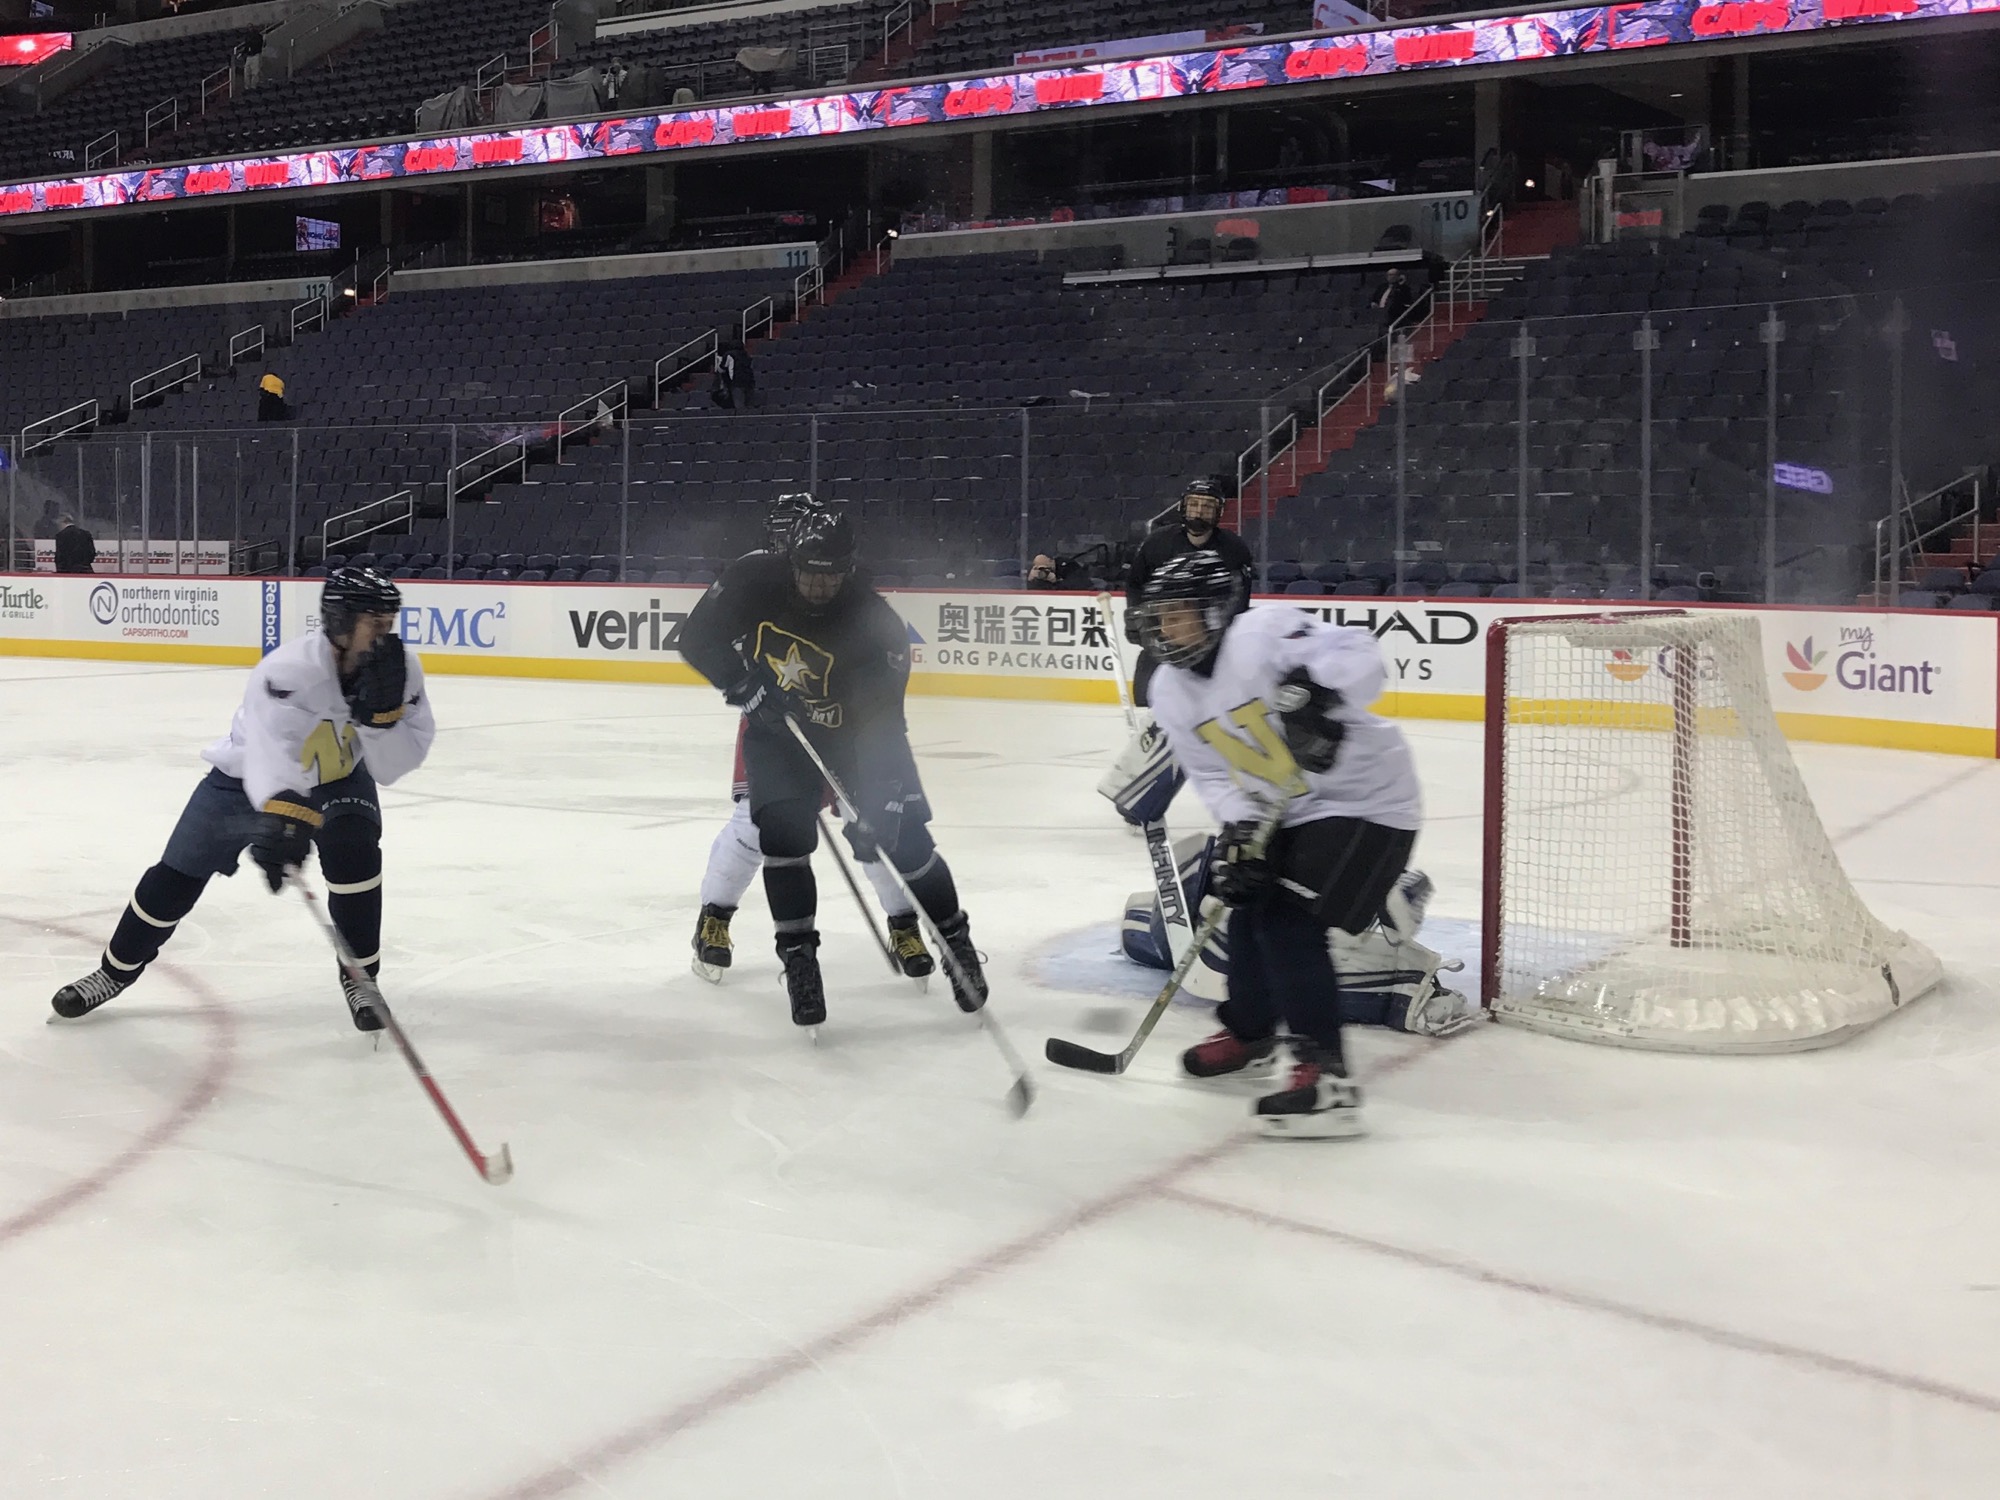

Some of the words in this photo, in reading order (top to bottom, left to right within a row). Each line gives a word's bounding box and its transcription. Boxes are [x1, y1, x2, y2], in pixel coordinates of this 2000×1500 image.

[1285, 44, 1367, 79] CAPS
[944, 85, 1014, 116] CAPS
[655, 119, 715, 147] CAPS
[404, 147, 456, 172] CAPS
[185, 171, 232, 193] CAPS
[1431, 200, 1469, 221] 110
[786, 250, 809, 267] 111
[306, 283, 326, 299] 112
[0, 585, 43, 609] Turtle
[122, 586, 170, 600] northern
[175, 586, 218, 603] virginia
[9, 611, 34, 619] GRILLE
[122, 603, 219, 626] orthodontics
[265, 581, 277, 647] Reebok
[569, 599, 688, 650] veriz
[938, 602, 1114, 648] 奥瑞金包装
[122, 628, 188, 638] CAPSORTHO.COM
[1838, 626, 1874, 652] my
[938, 649, 979, 666] ORG
[988, 651, 1114, 671] PACKAGING
[1836, 651, 1933, 695] Giant
[322, 797, 377, 811] EASTON
